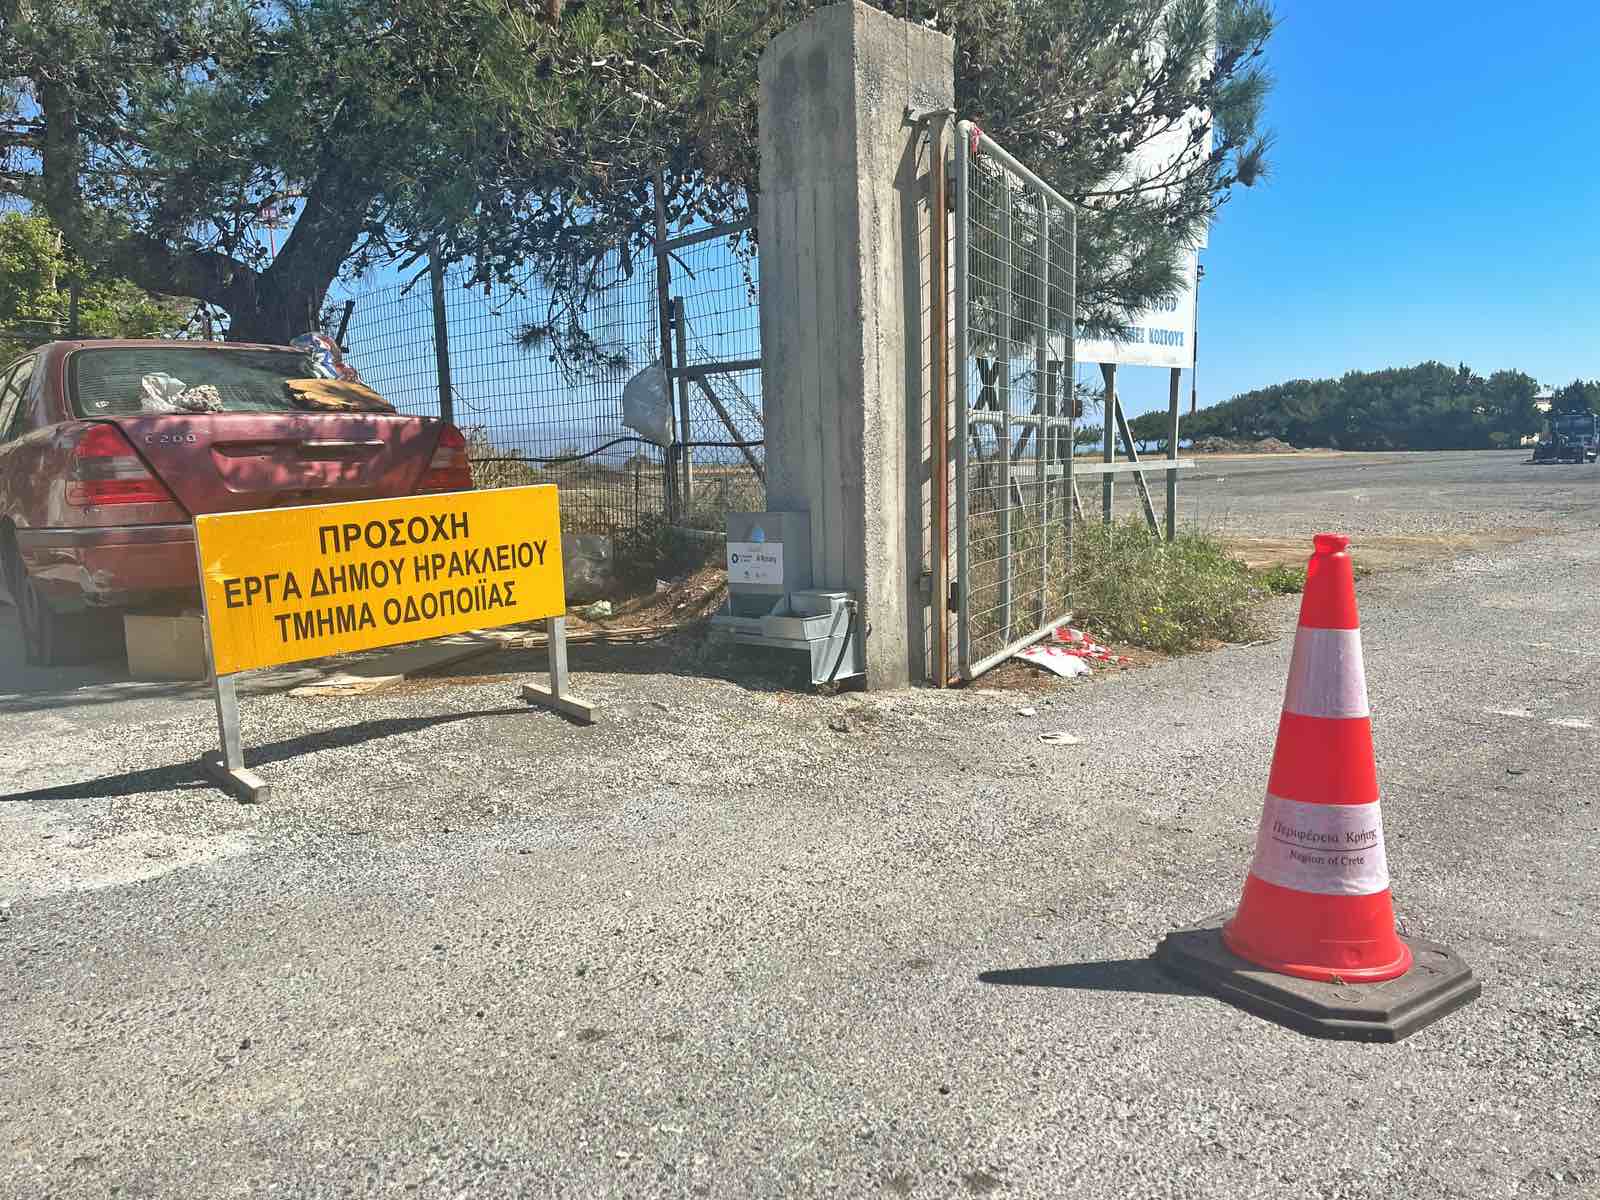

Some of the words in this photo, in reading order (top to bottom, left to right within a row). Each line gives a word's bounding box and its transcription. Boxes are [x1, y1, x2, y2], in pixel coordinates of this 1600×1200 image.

[159, 433, 197, 444] 200
[319, 511, 469, 555] ΠΡΟΣΟΧΗ
[223, 571, 302, 609] ΕΡΓΑ
[310, 557, 405, 599] ΔΗΜΟΥ
[413, 539, 547, 583] ΗΡΑΚΛΕΙΟΥ
[274, 602, 376, 643] ΤΜΗΜΑ
[383, 578, 517, 626] ΟΔΟΠΟΙΪΑΣ
[1327, 855, 1339, 866] of
[1340, 855, 1365, 867] Crete
